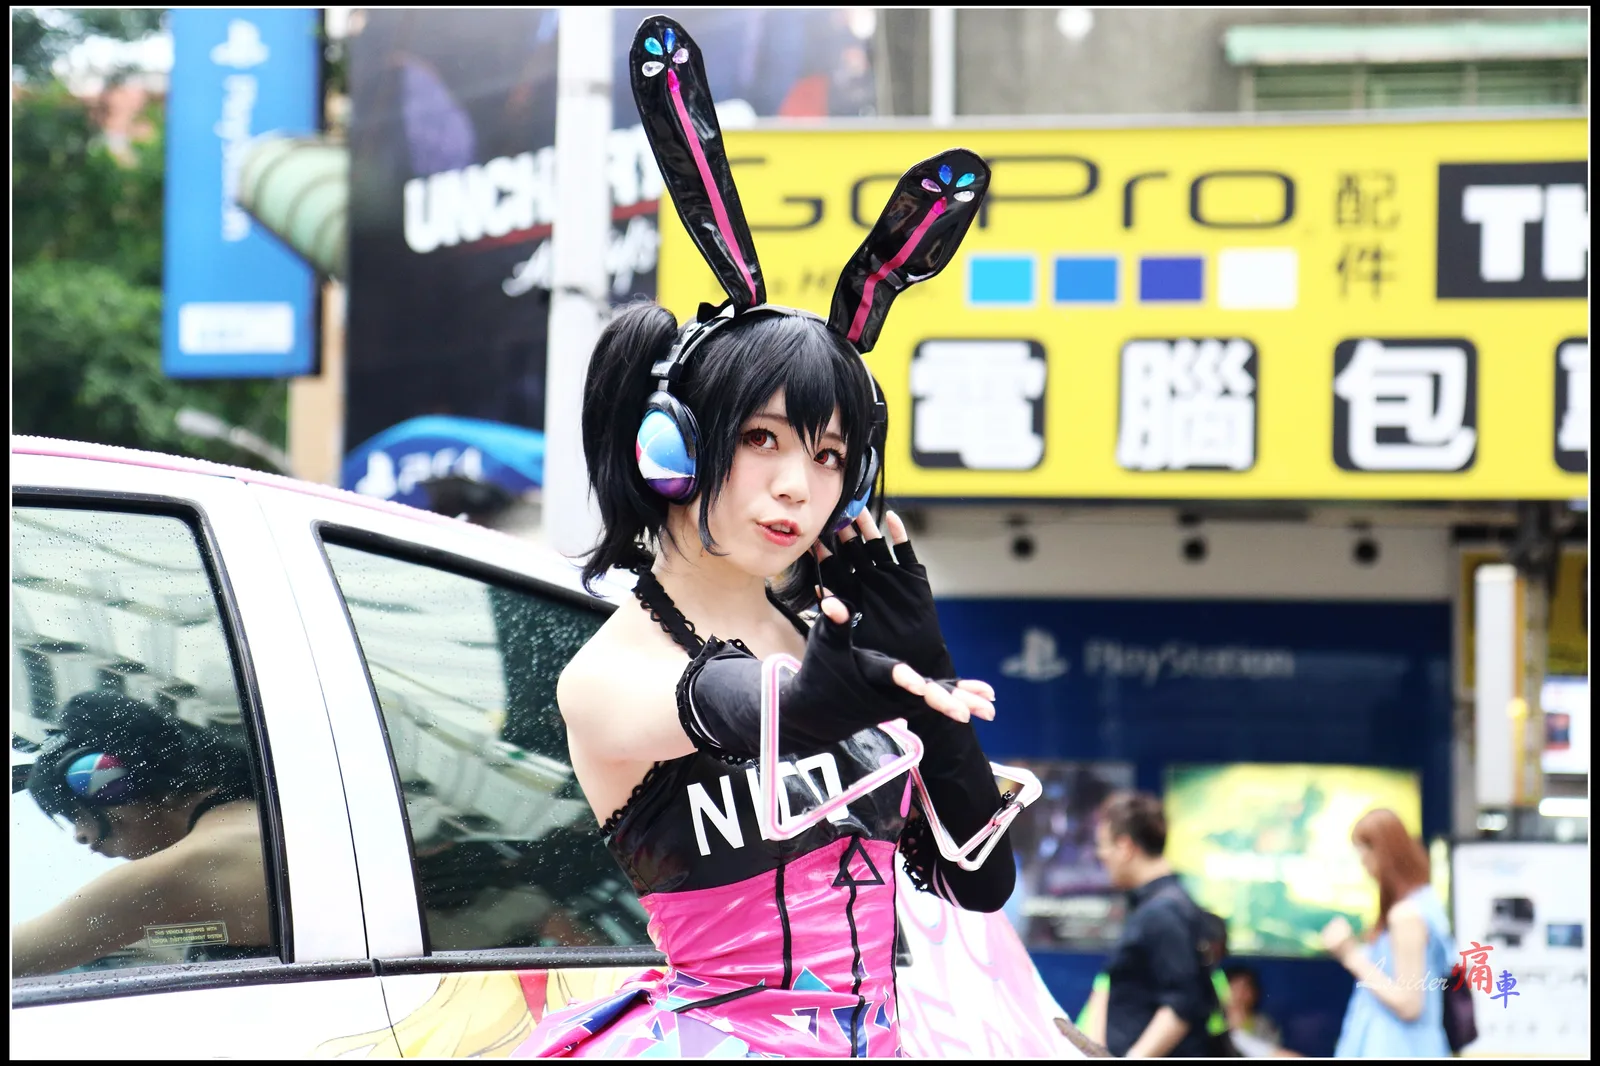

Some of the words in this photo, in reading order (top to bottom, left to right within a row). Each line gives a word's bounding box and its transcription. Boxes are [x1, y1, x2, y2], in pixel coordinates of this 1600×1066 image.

[1334, 172, 1402, 299] 配件
[908, 337, 1588, 472] 電腦包
[1083, 637, 1296, 688] PlayStation
